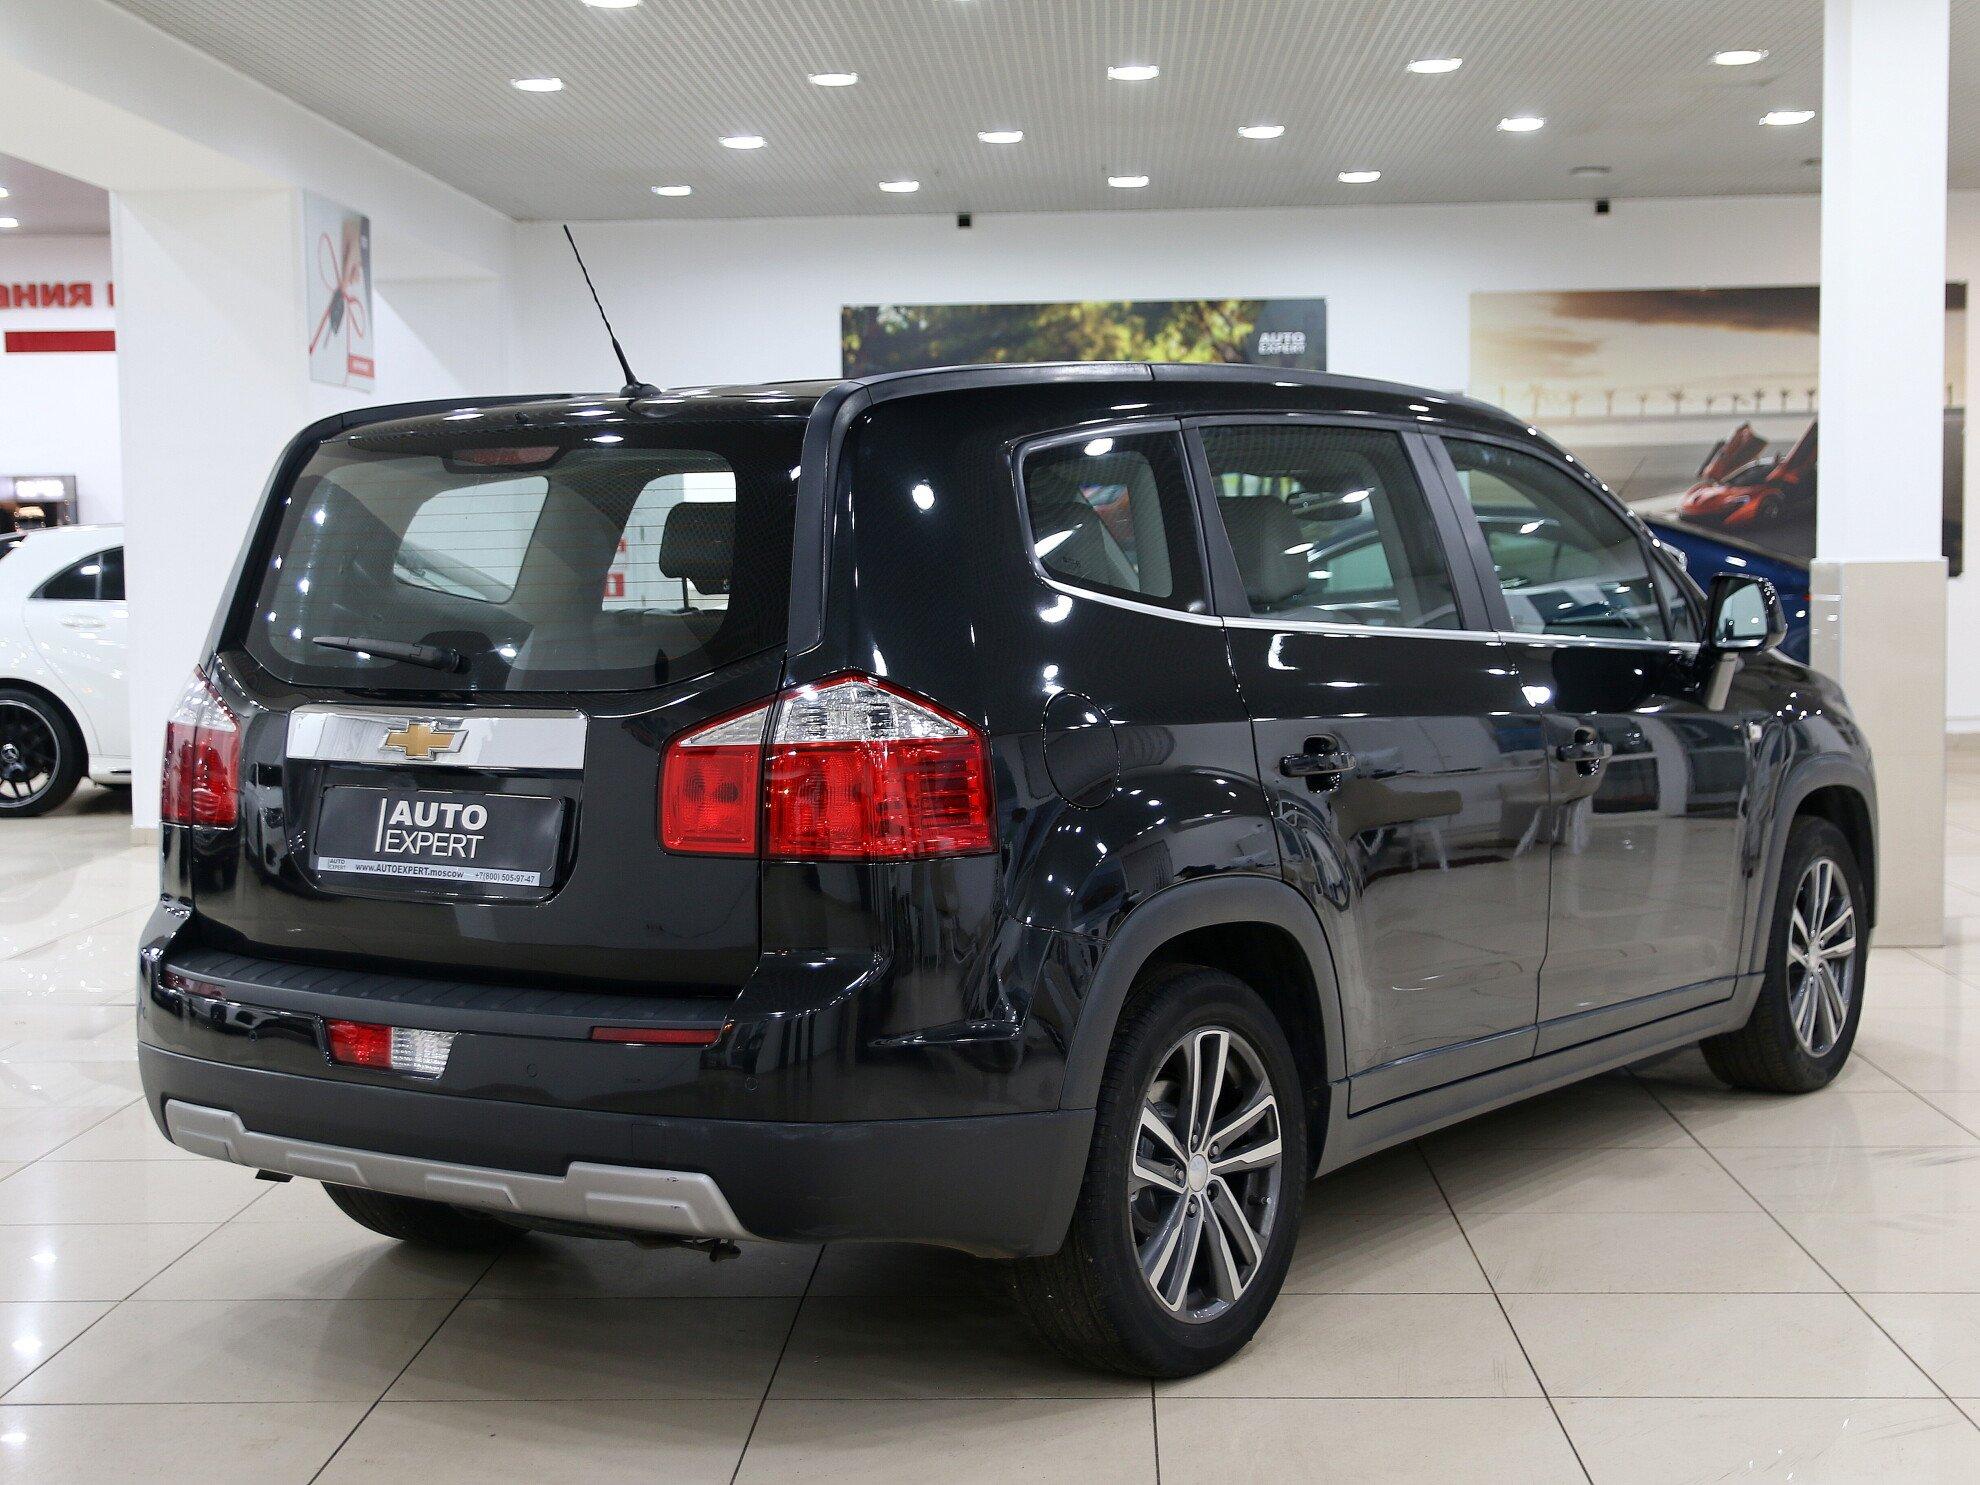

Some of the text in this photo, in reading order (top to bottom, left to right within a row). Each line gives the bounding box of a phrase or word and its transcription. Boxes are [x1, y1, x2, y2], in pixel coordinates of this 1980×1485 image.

[1259, 332, 1306, 343] AUTO
[388, 800, 488, 831] AUTO
[384, 829, 484, 859] EXPERT
[355, 864, 464, 878] www.AUTOEXPERT.moscow
[475, 871, 535, 884] +7(800) 505-97-47
